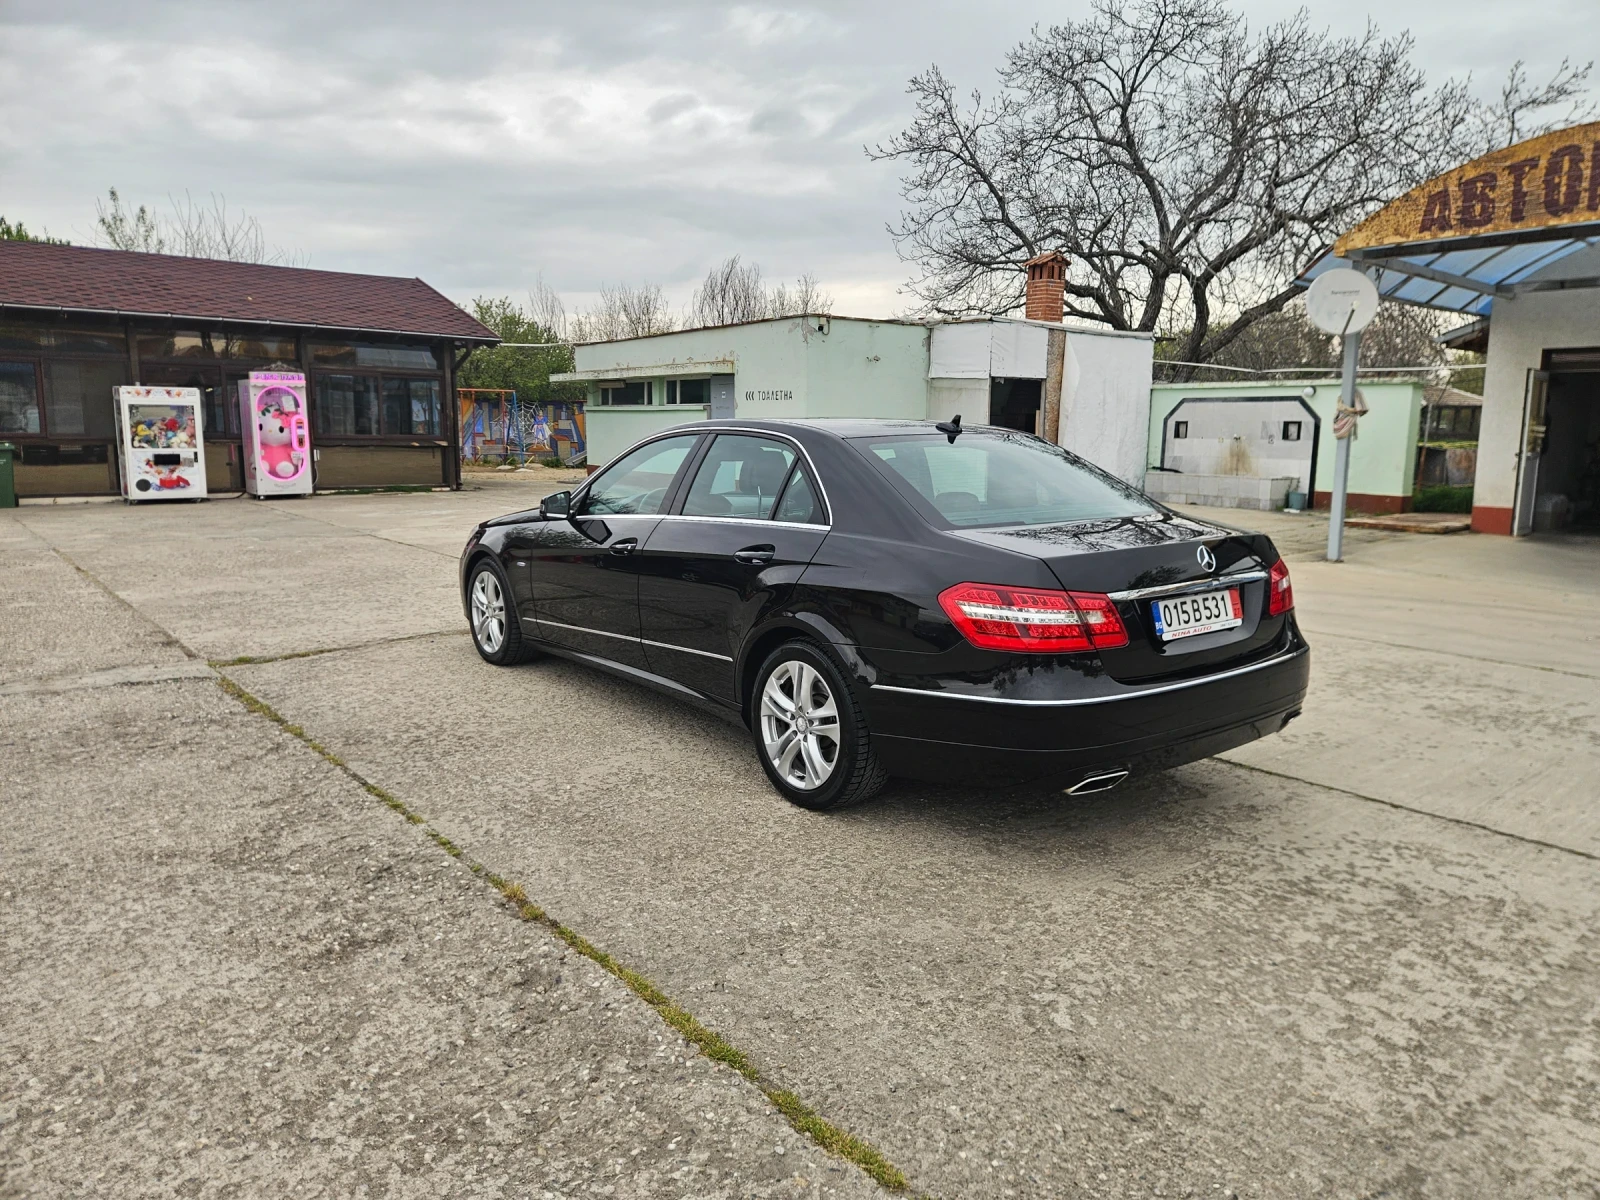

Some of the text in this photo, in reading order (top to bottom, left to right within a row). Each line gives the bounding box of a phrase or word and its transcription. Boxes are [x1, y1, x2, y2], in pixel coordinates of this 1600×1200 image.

[757, 390, 793, 401] ТОАЛЕТНА
[1163, 594, 1229, 628] 015B531
[1155, 621, 1163, 630] BG
[1171, 625, 1212, 638] NINA AUTO
